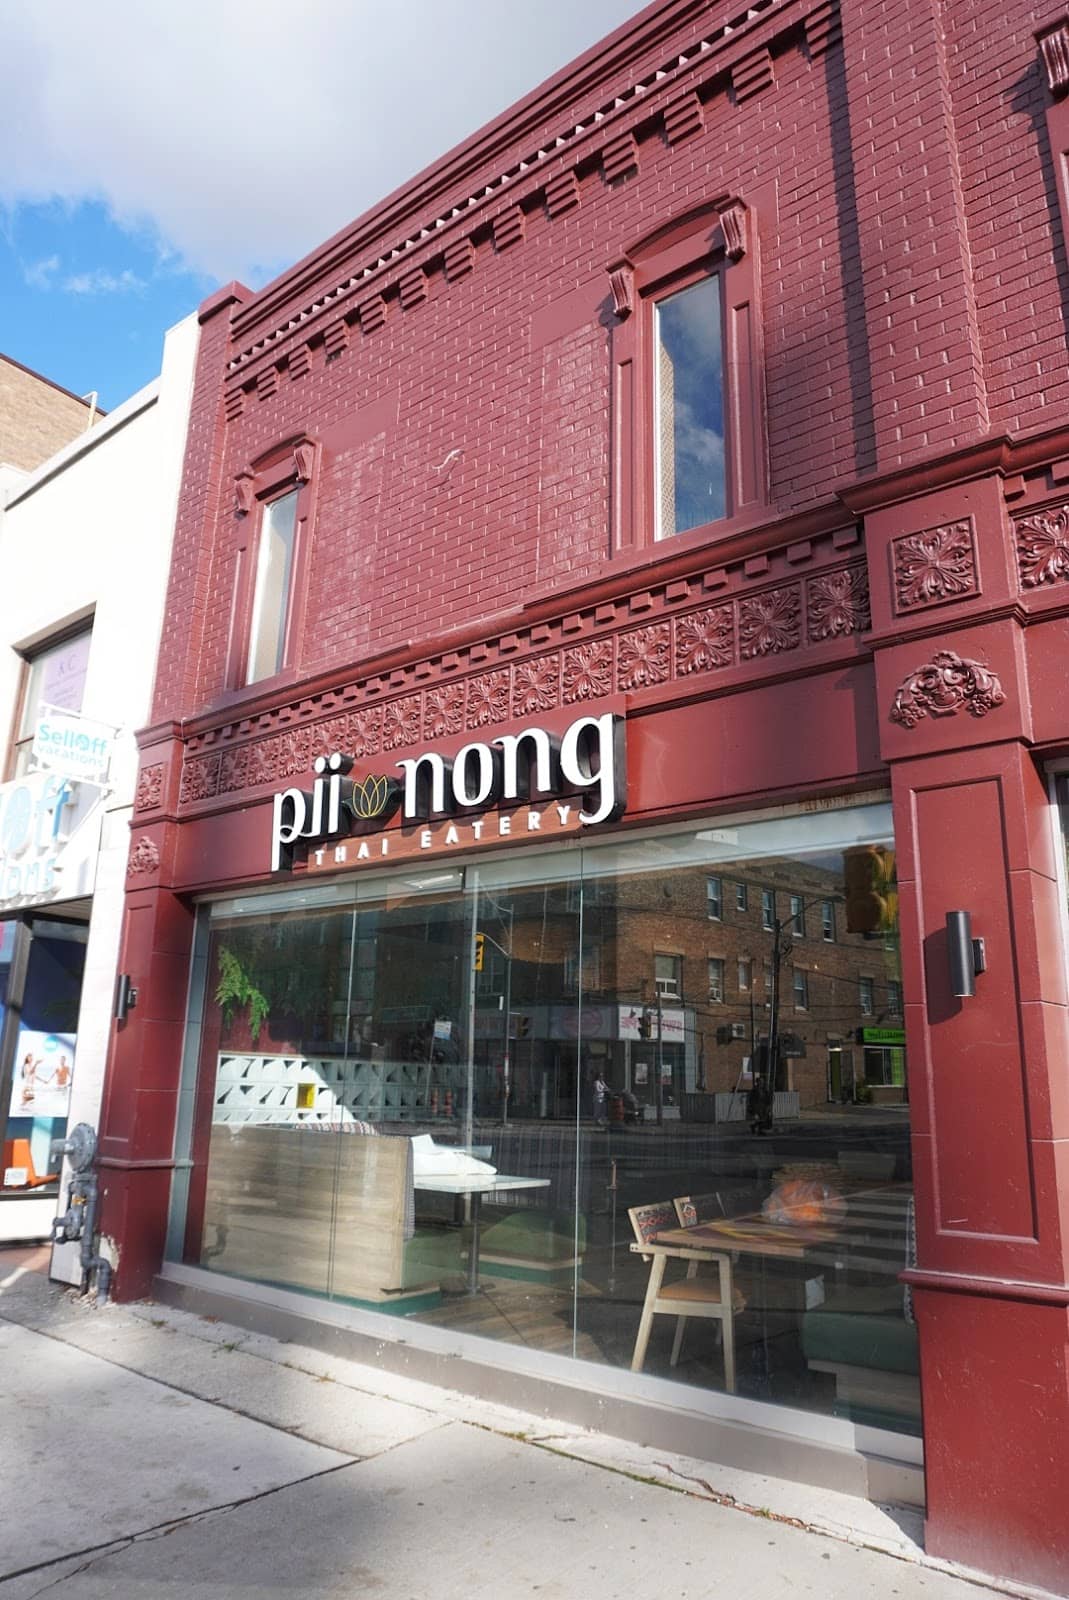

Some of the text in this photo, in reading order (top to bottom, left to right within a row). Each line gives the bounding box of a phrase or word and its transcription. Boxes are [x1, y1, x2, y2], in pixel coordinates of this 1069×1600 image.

[37, 744, 105, 769] vacations
[38, 722, 108, 757] SellOff
[271, 712, 616, 872] pii nong
[314, 804, 572, 866] THAI EATERY
